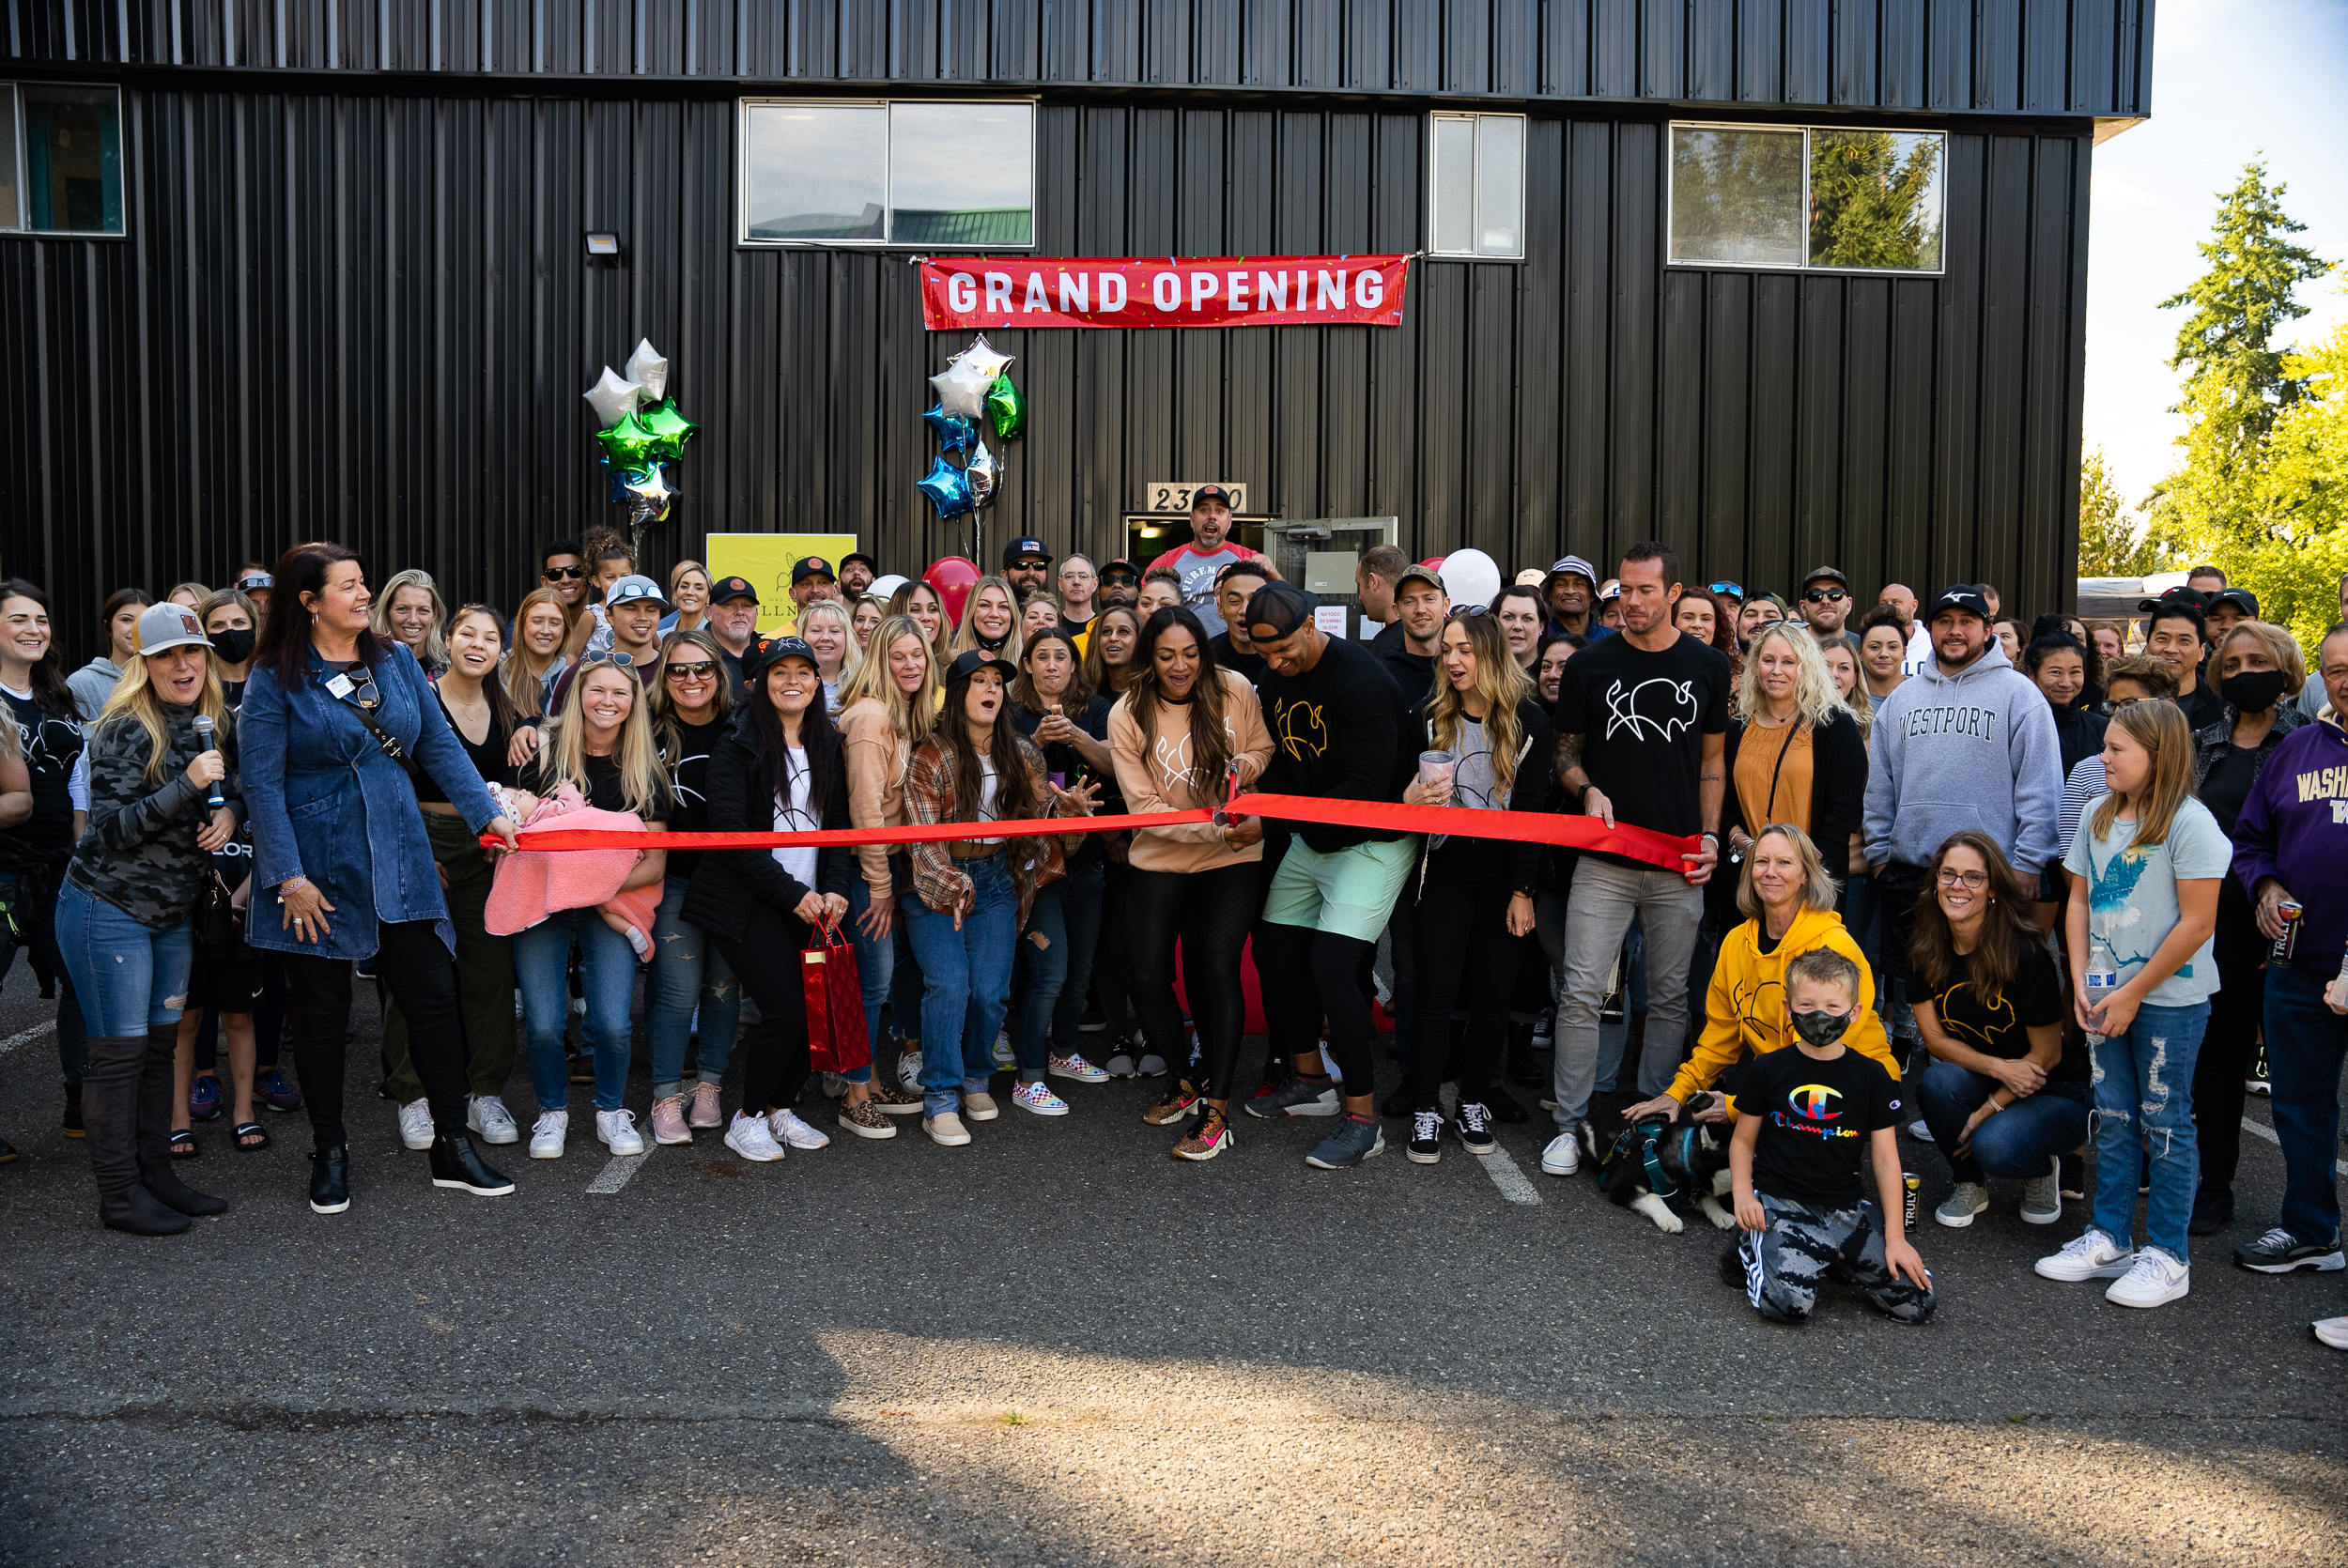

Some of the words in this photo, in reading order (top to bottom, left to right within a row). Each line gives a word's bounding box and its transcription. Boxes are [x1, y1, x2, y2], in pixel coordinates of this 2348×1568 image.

[948, 271, 1128, 314] GRAND
[1152, 269, 1383, 312] OPENING
[1899, 706, 1997, 744] WESTPORT
[2273, 920, 2290, 957] TRULY
[1769, 1111, 1860, 1141] Champion
[1905, 1191, 1917, 1227] TRULY
